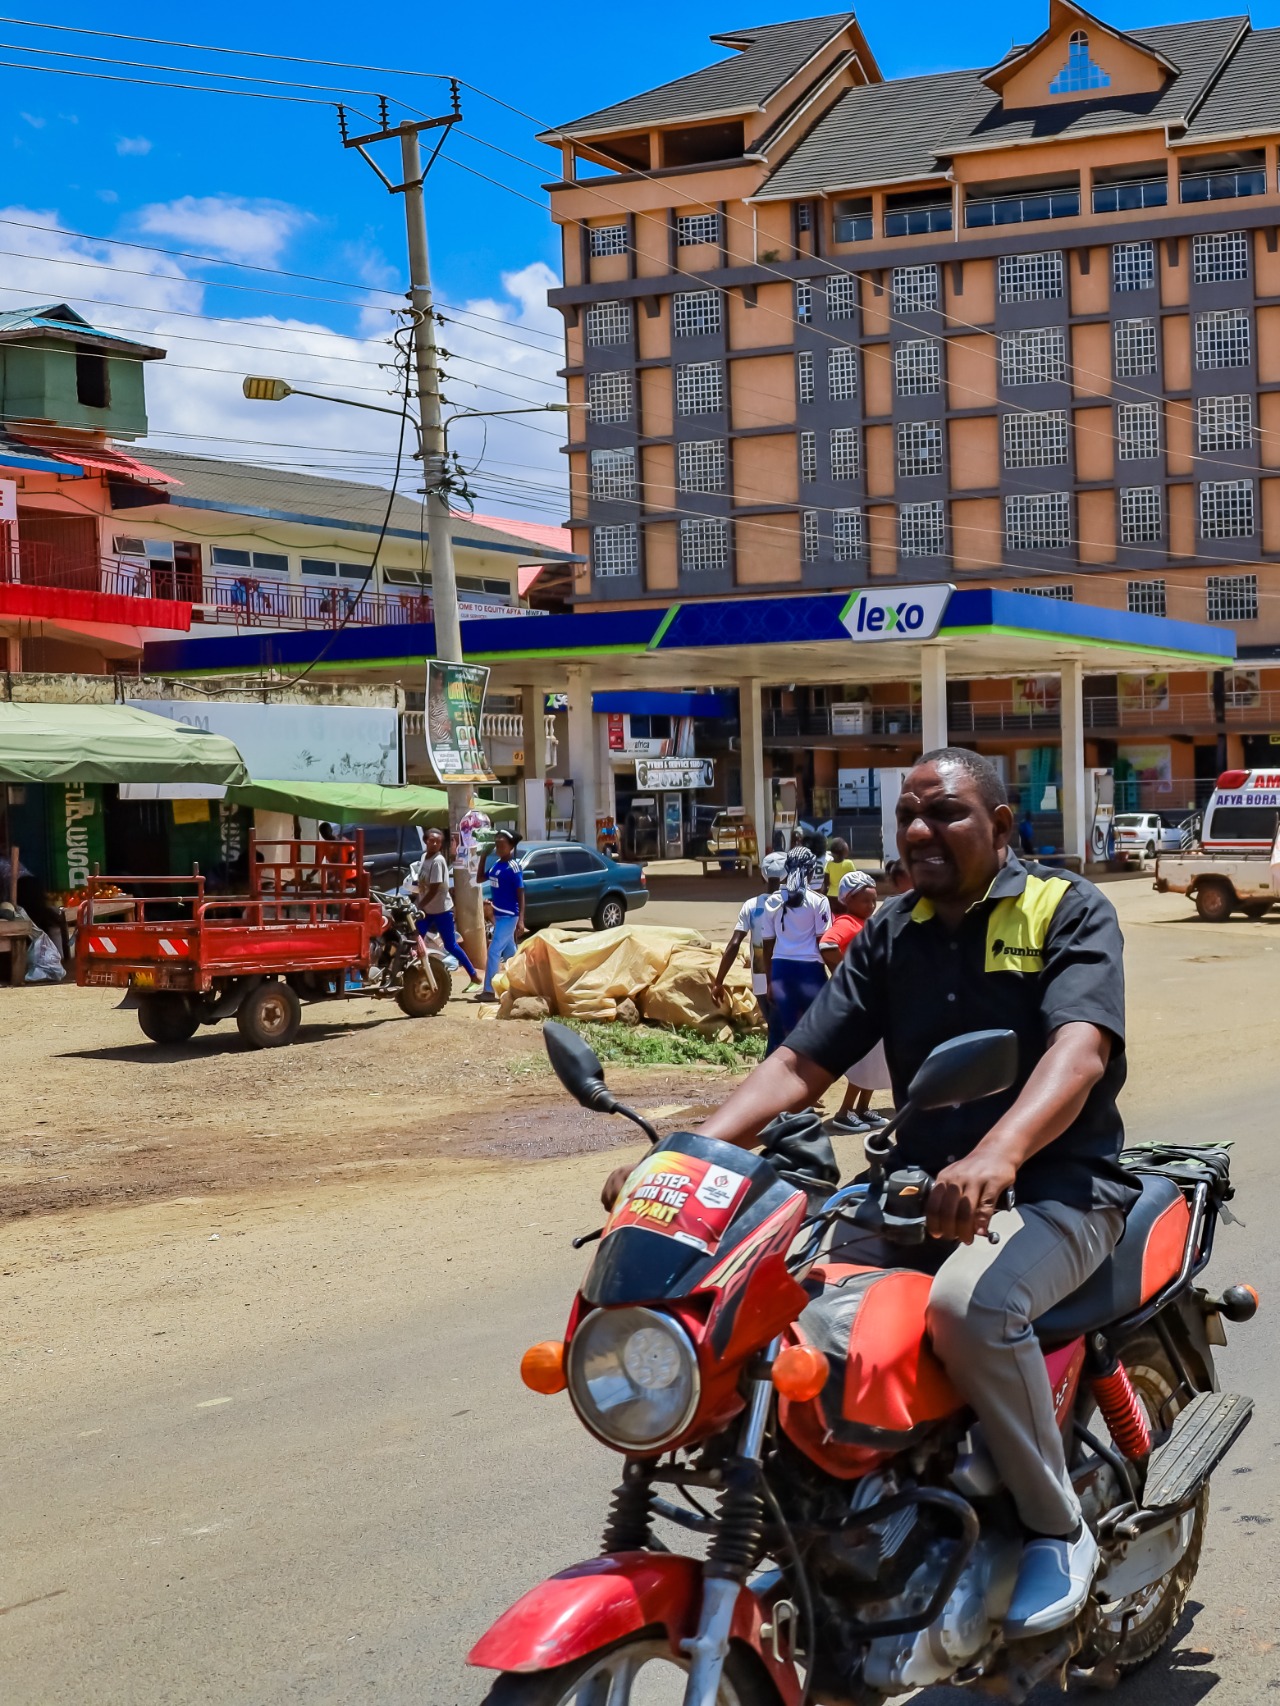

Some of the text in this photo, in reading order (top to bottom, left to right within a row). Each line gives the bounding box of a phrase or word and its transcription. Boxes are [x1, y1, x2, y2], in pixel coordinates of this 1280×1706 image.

[484, 605, 505, 614] EQUITY
[857, 597, 924, 632] lexo
[1216, 794, 1243, 805] AFYA
[1246, 794, 1277, 805] BORA
[654, 1172, 691, 1189] STEP
[658, 1187, 689, 1208] THE
